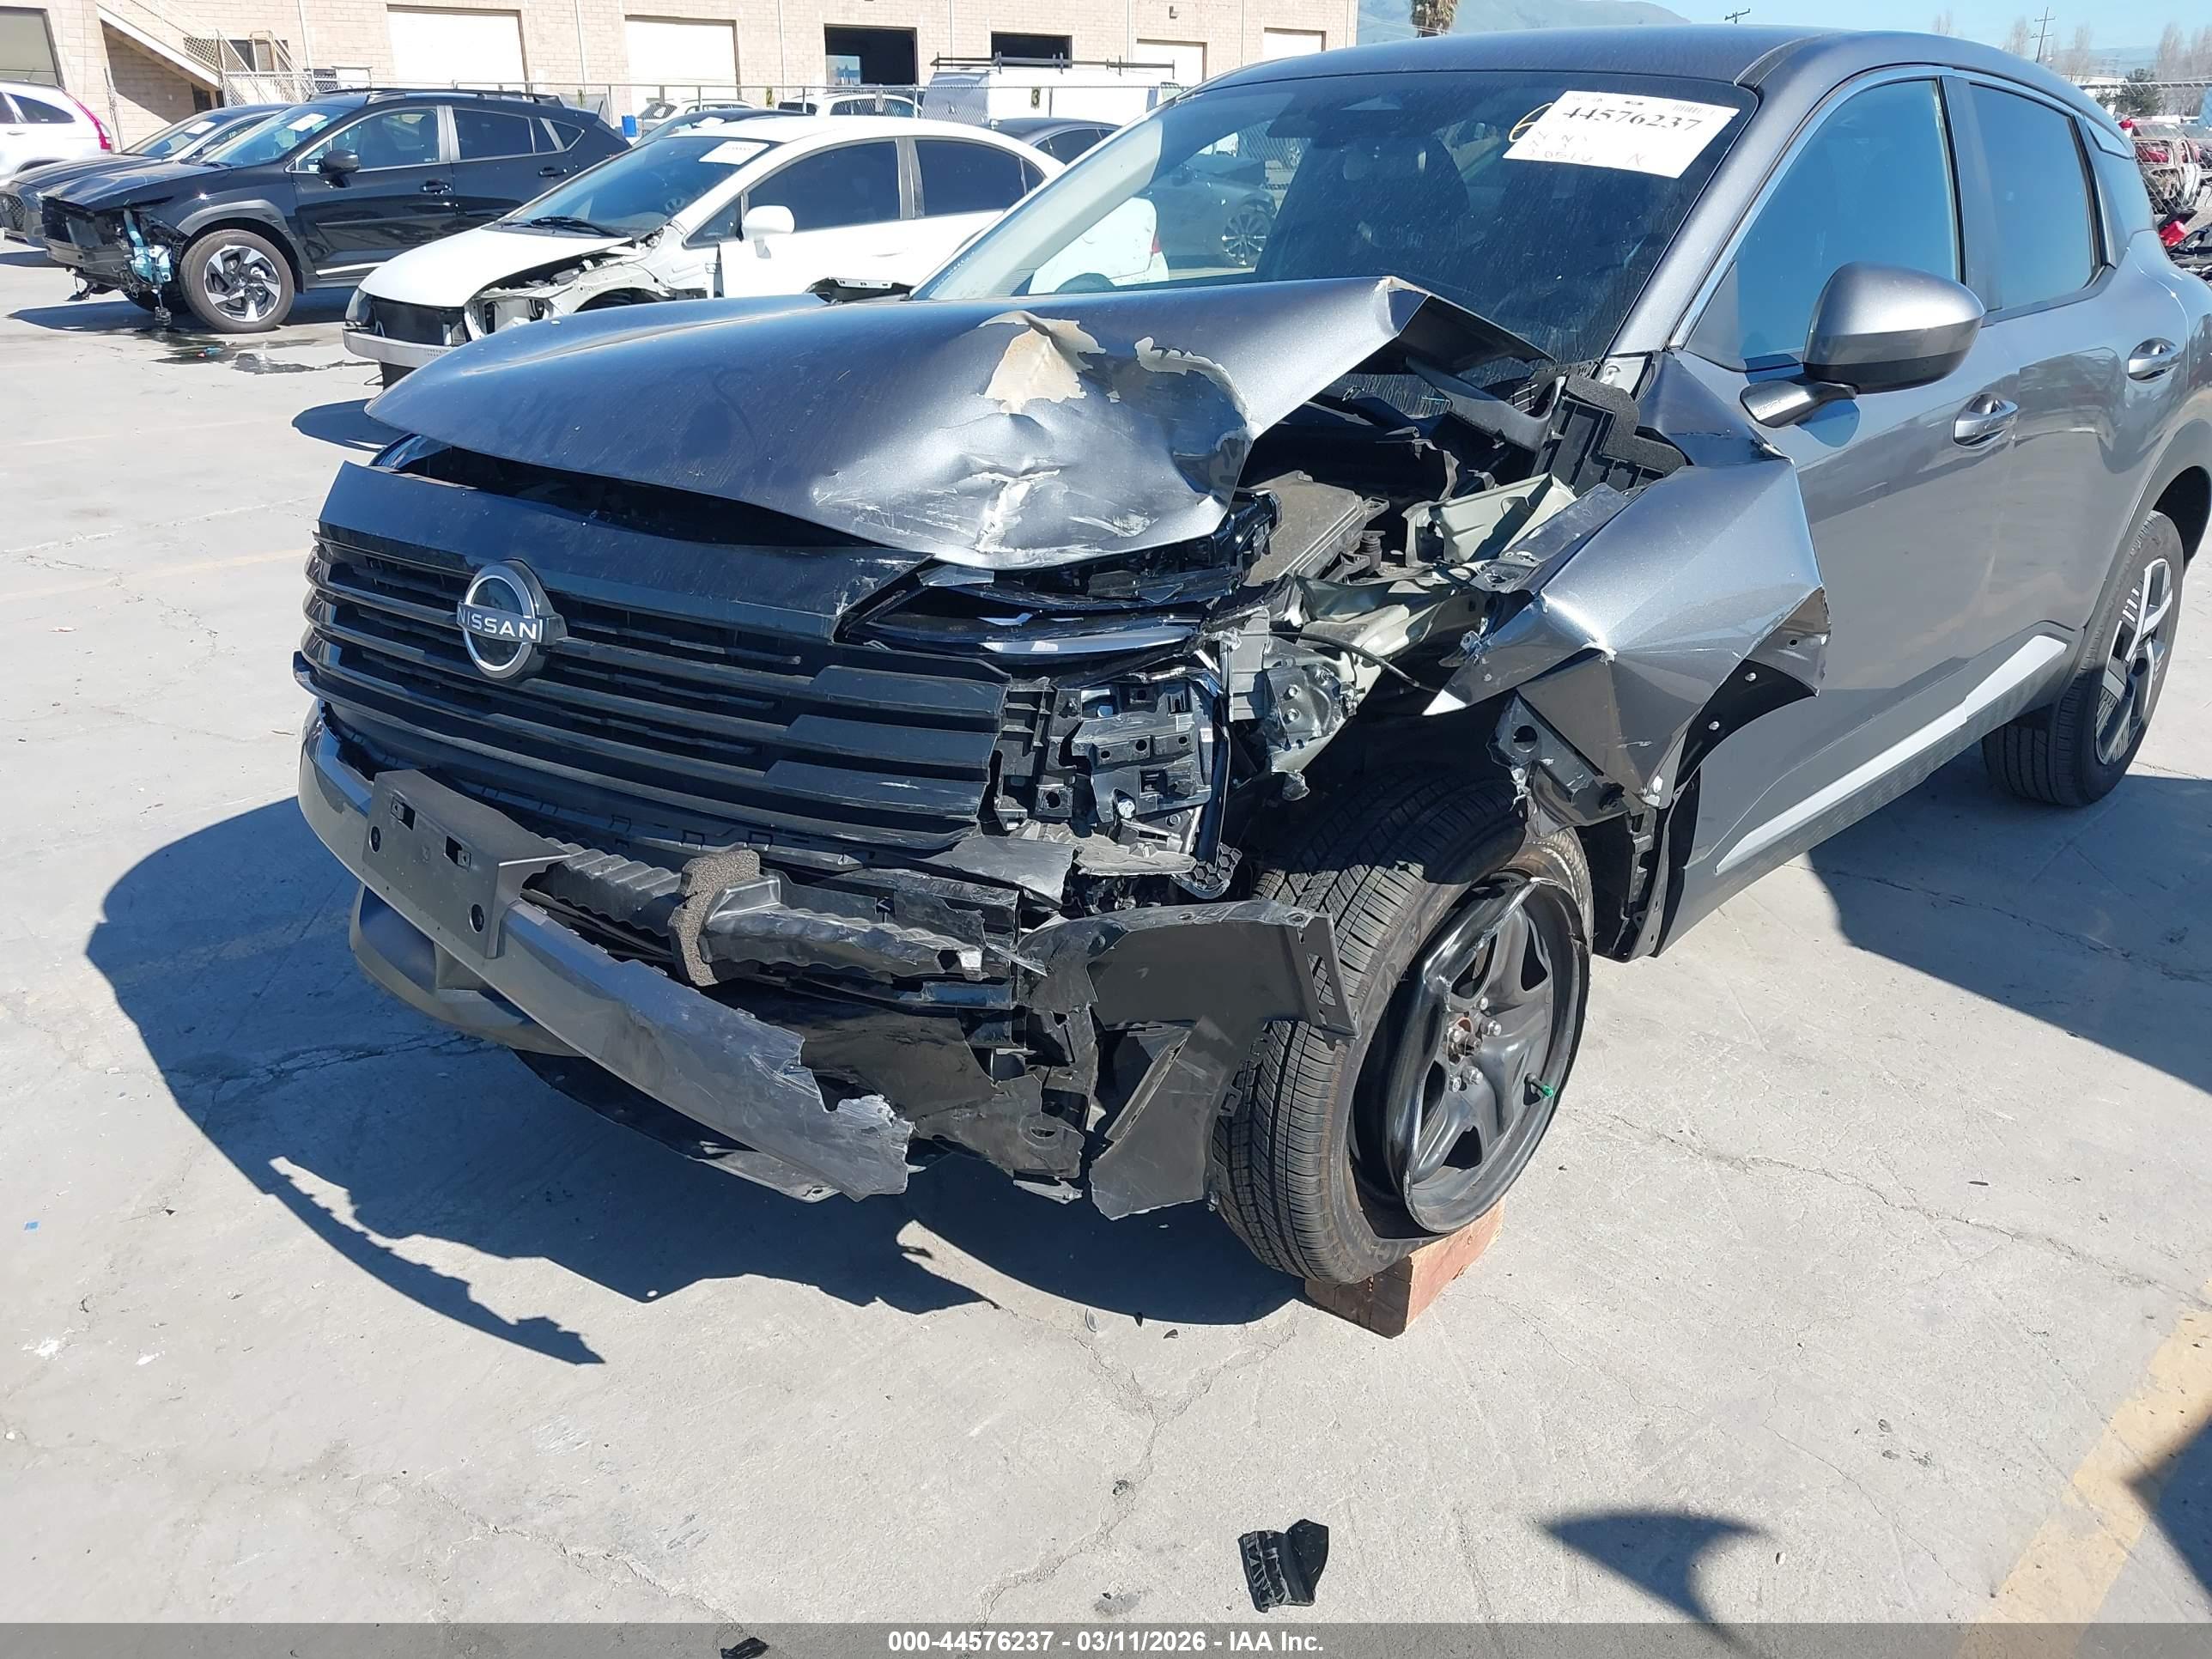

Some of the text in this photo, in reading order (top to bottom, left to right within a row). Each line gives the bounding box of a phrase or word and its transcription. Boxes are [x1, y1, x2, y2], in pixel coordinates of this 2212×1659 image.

[766, 90, 773, 105] 2
[1031, 88, 1040, 106] 3
[1562, 106, 1703, 131] 44576237
[457, 608, 537, 640] NISSAN
